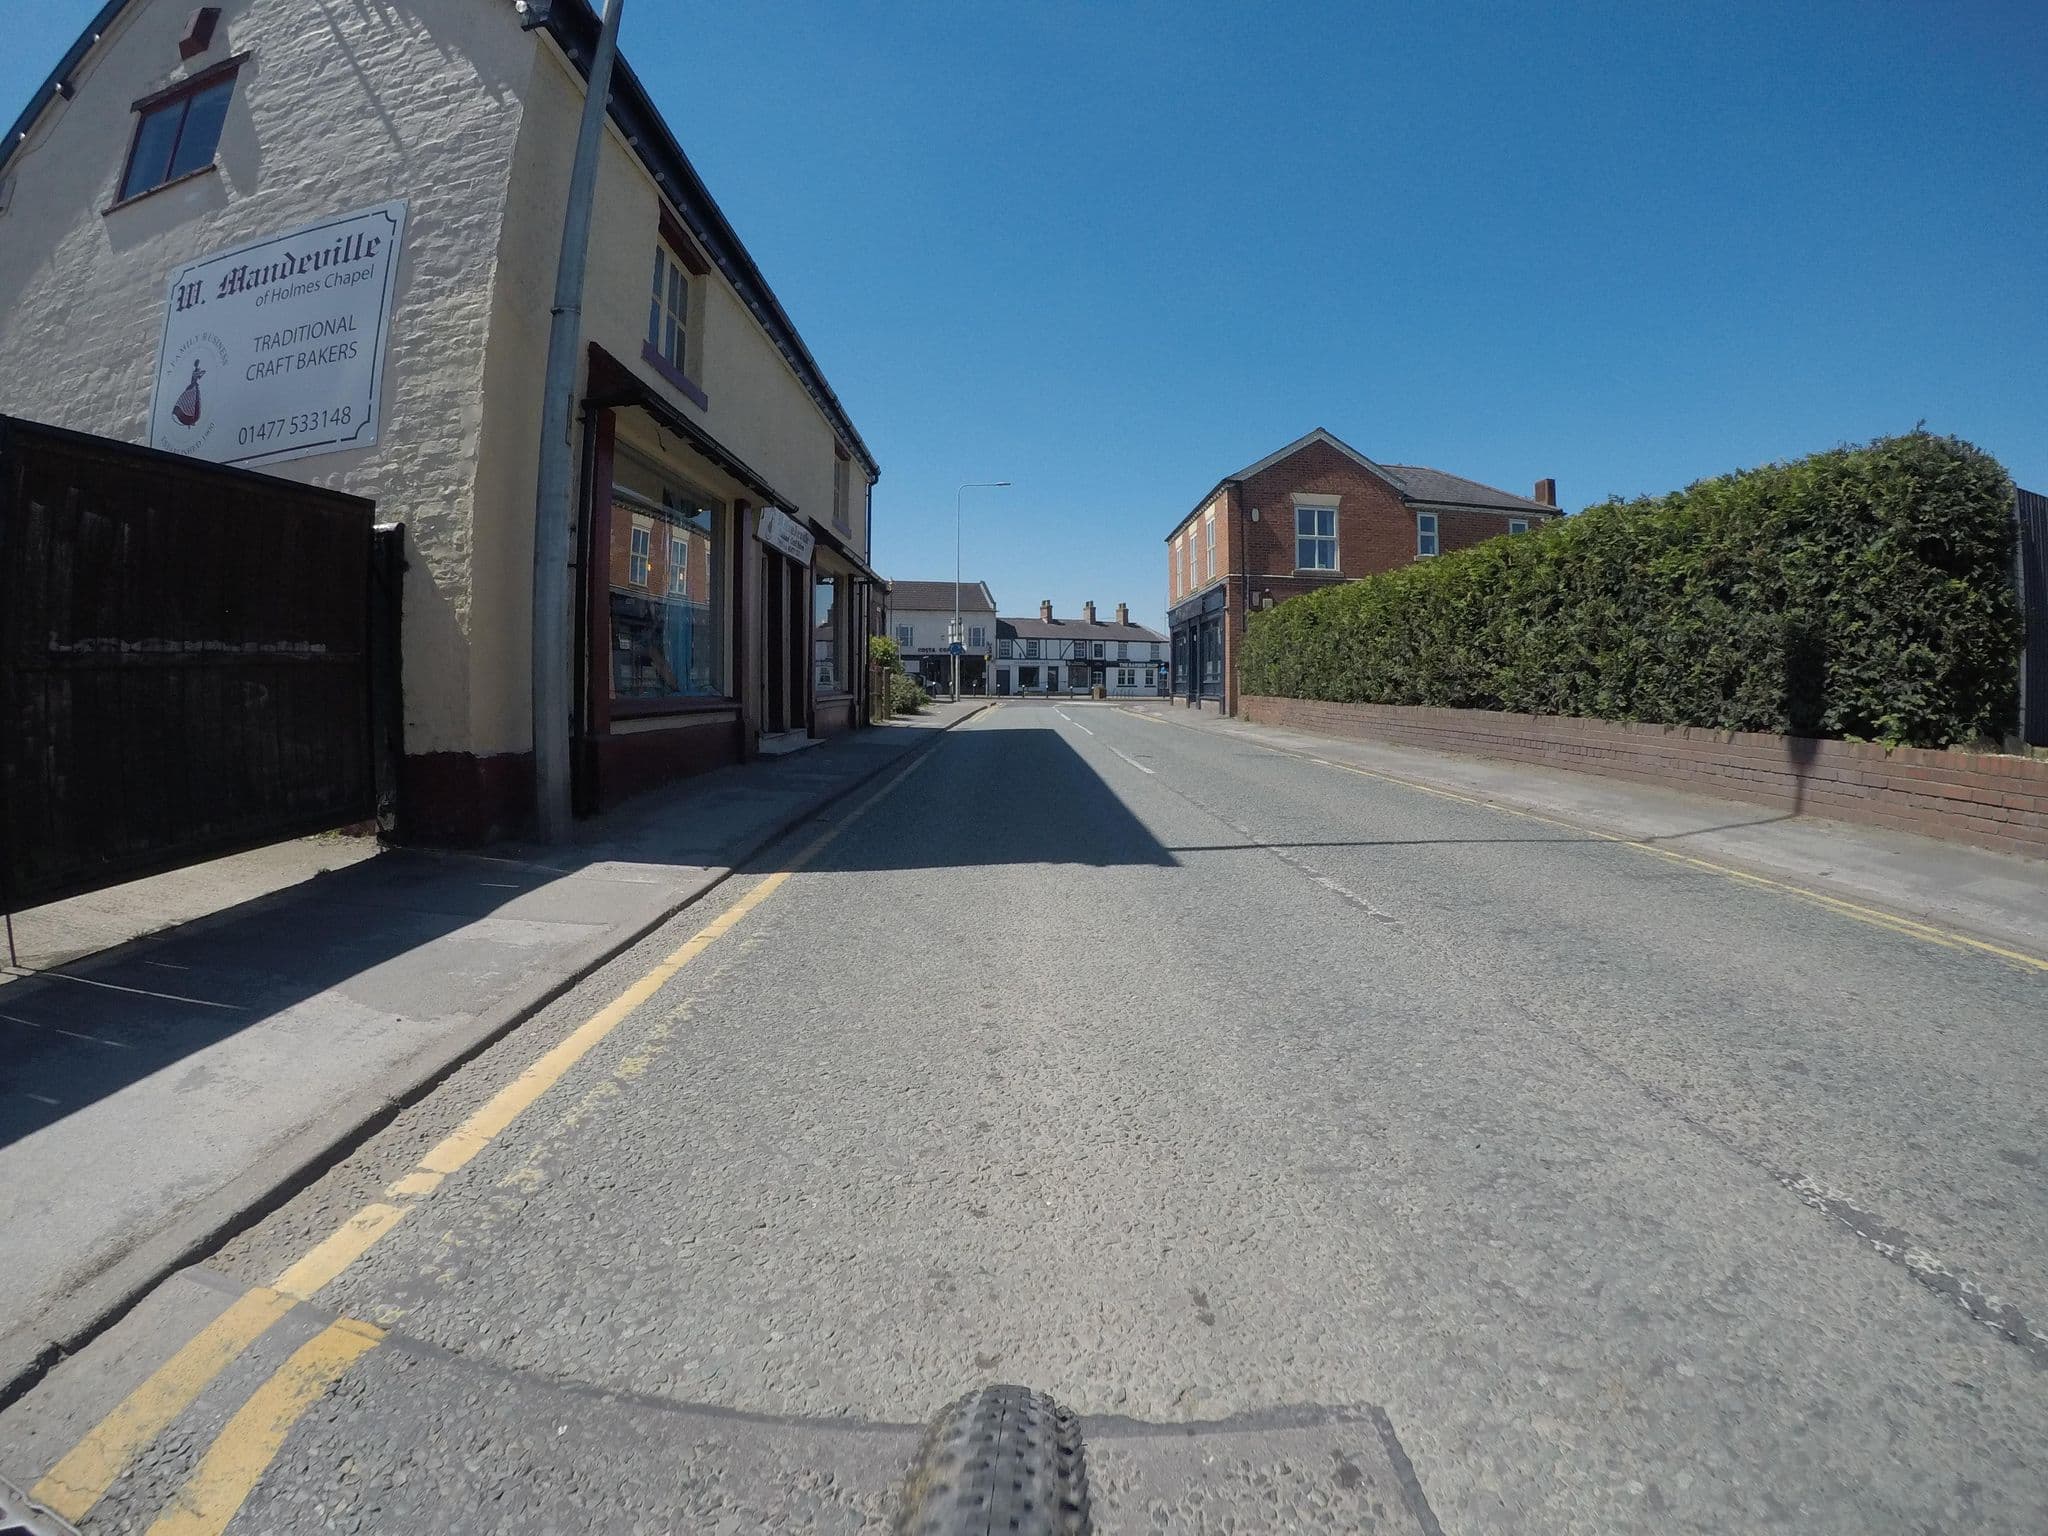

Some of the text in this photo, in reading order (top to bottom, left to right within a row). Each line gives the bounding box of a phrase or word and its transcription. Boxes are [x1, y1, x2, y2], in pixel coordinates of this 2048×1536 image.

[176, 231, 381, 312] W. Mandeville
[255, 264, 375, 307] of Holmes Chapel
[254, 314, 358, 352] TRADITIONAL
[245, 340, 358, 381] CRAFT BAKERS
[238, 418, 285, 445] 01477
[289, 406, 351, 435] 533148
